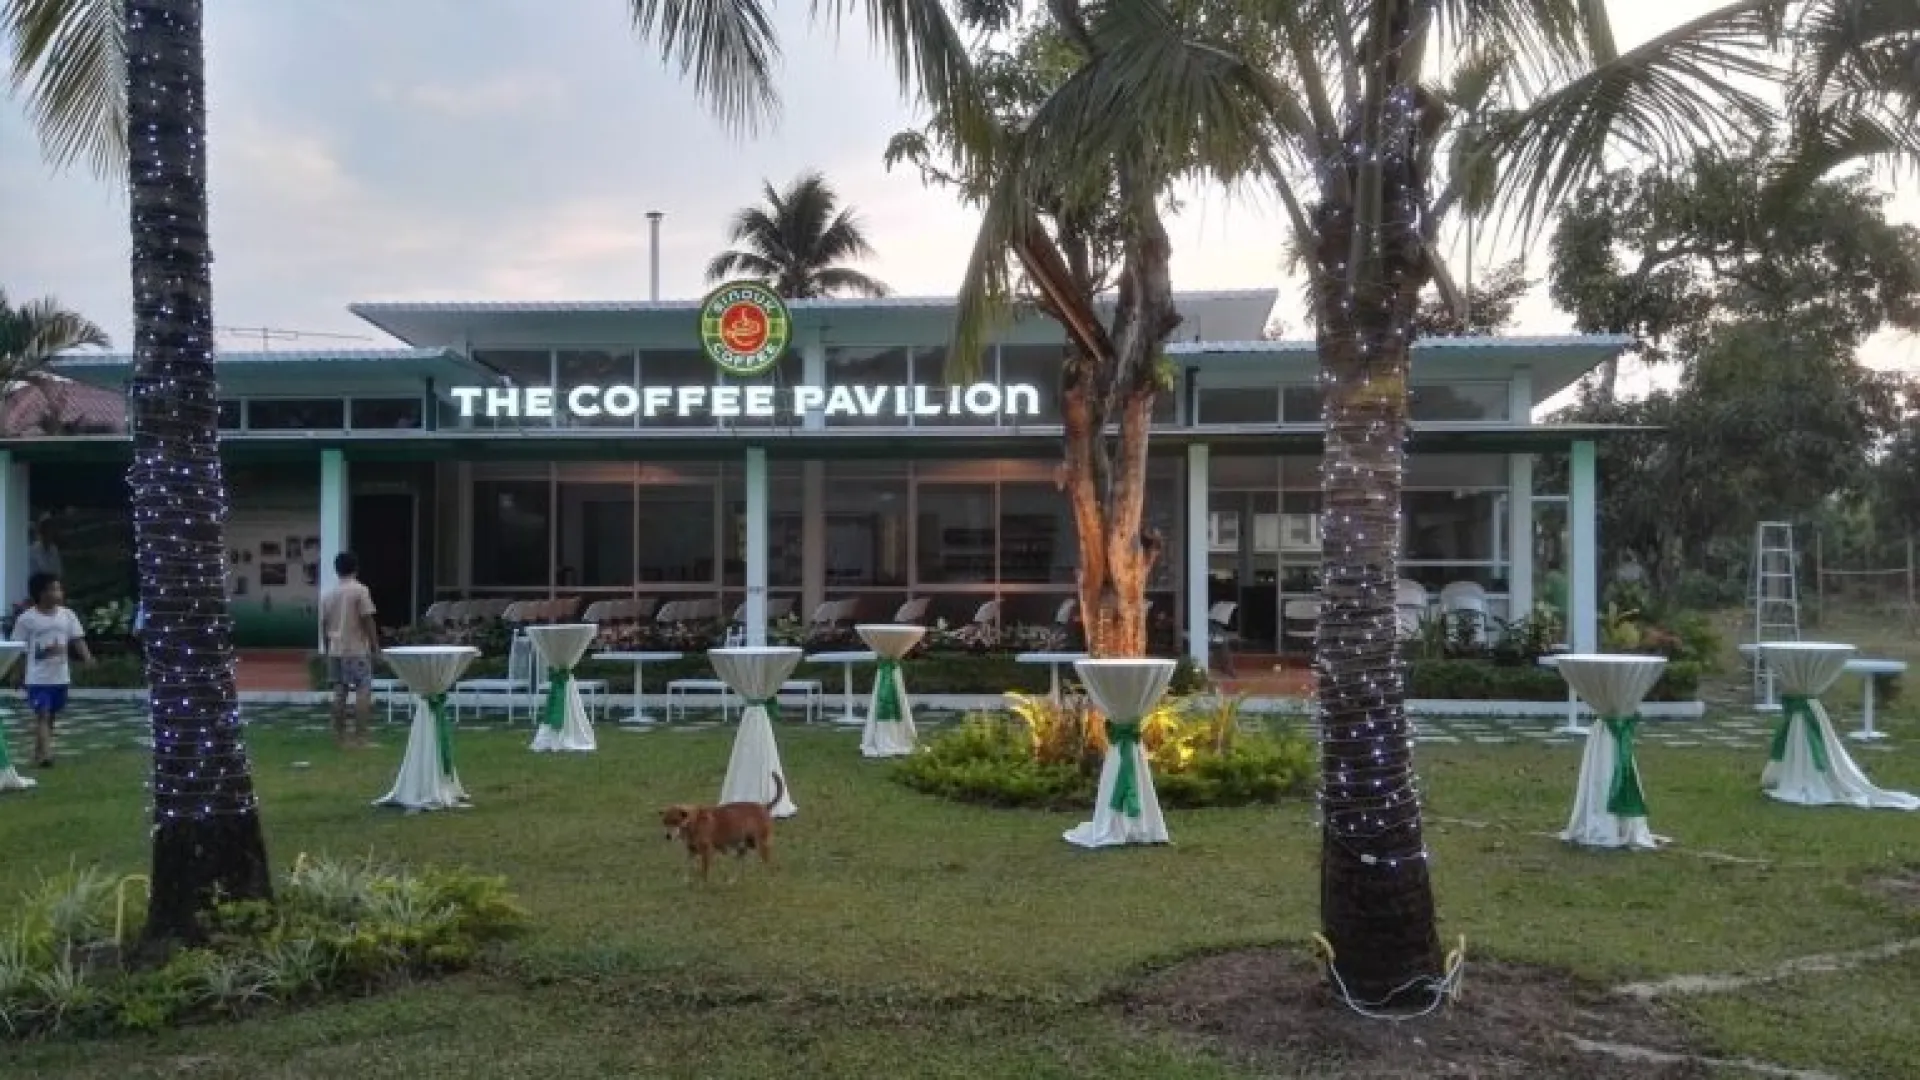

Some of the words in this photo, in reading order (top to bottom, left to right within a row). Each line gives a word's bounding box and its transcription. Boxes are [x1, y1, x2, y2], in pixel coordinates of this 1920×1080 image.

[713, 343, 777, 367] COFFEE
[451, 387, 554, 418] THE
[567, 385, 774, 418] COFFEE
